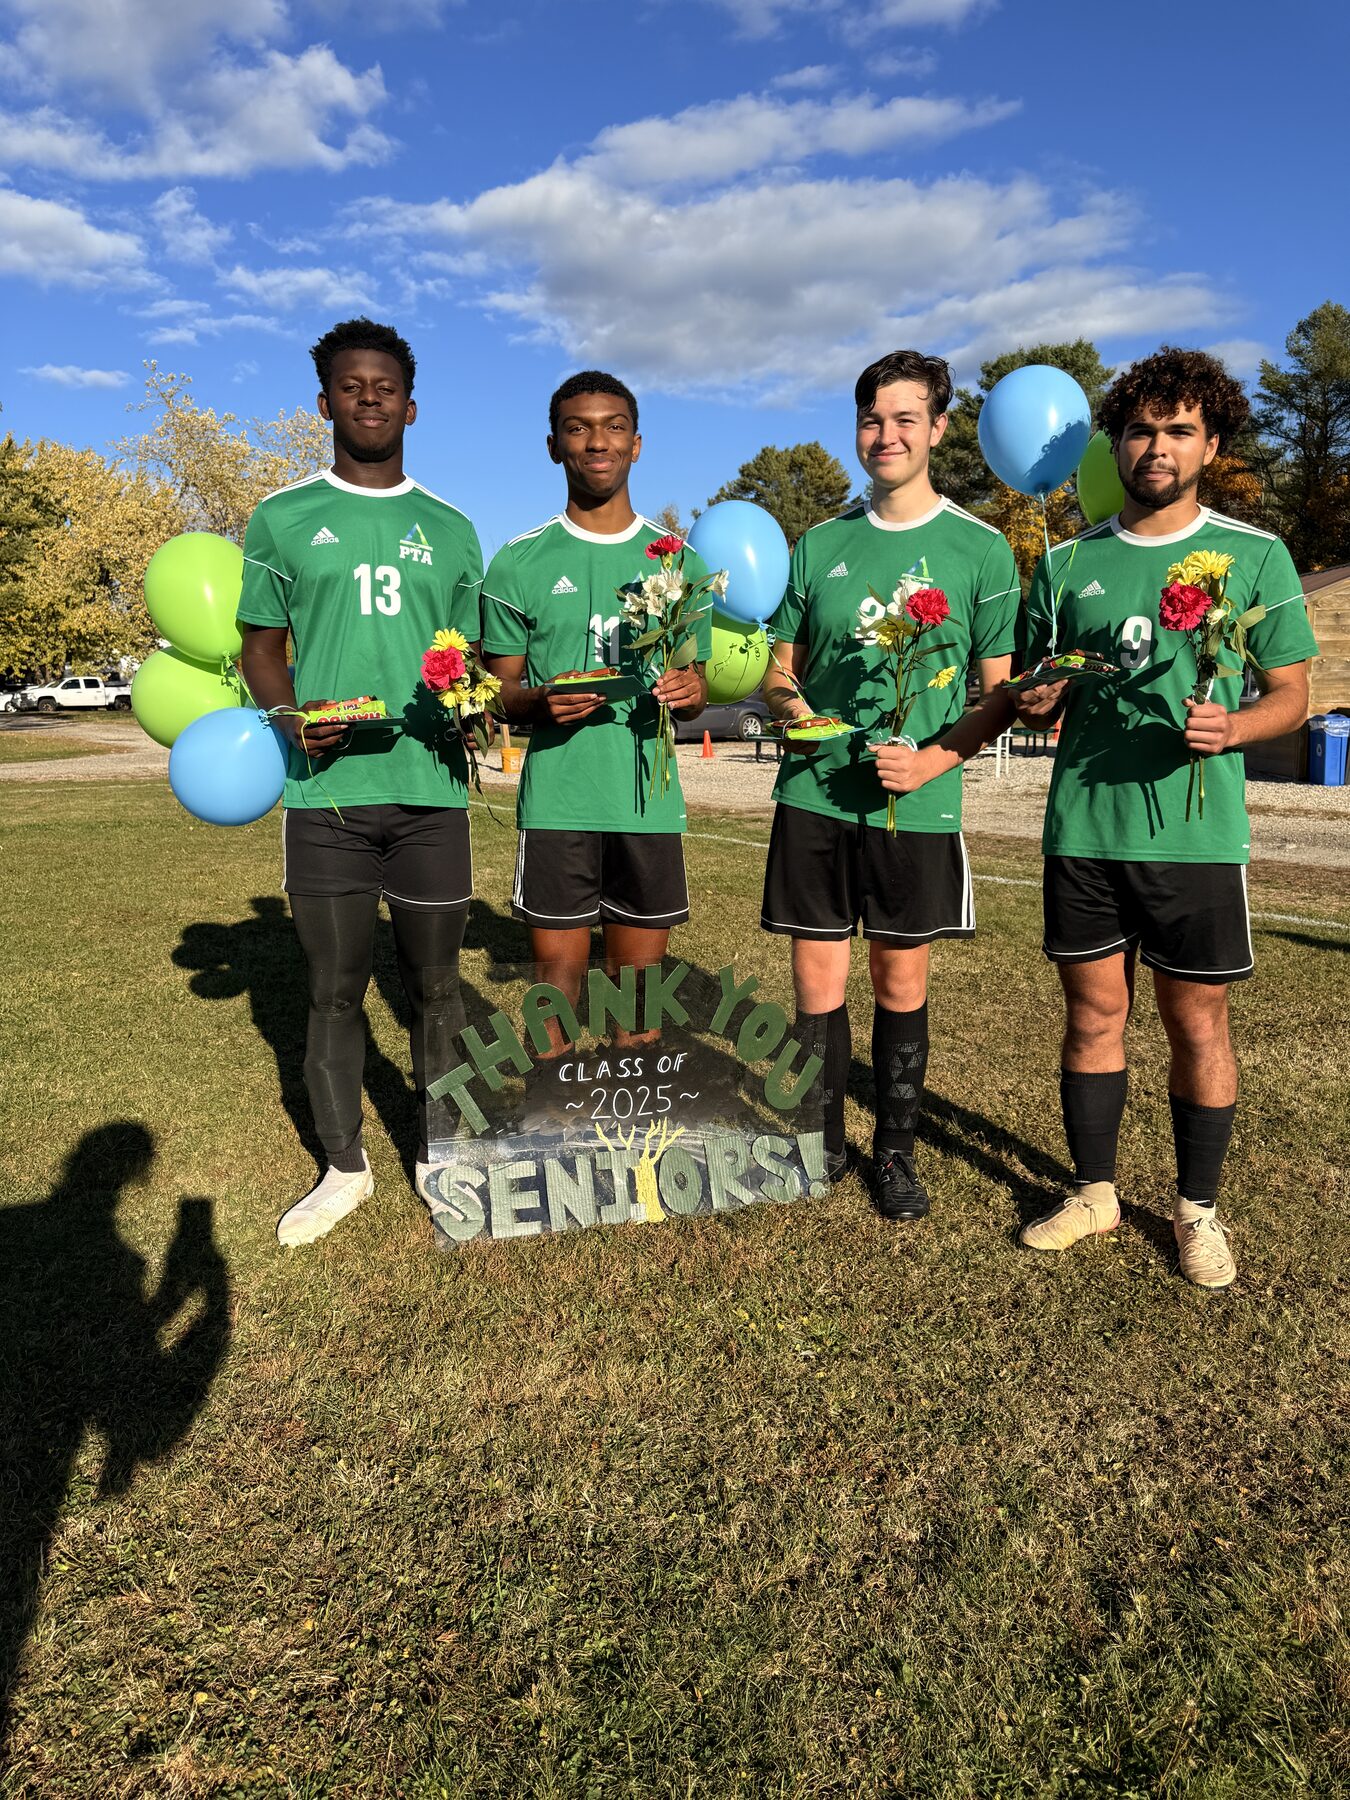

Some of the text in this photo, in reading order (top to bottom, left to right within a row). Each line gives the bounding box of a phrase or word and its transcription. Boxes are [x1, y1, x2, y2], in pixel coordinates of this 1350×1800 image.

[311, 537, 340, 546] adidas
[400, 545, 433, 566] PTA
[353, 563, 402, 616] 13
[551, 586, 578, 594] adidas
[1078, 588, 1106, 598] adidas
[589, 613, 620, 664] 11
[1120, 615, 1152, 669] 9
[426, 960, 824, 1135] THANK YOU
[559, 1052, 689, 1083] CLASS OF
[431, 1130, 829, 1242] SENIORS!
